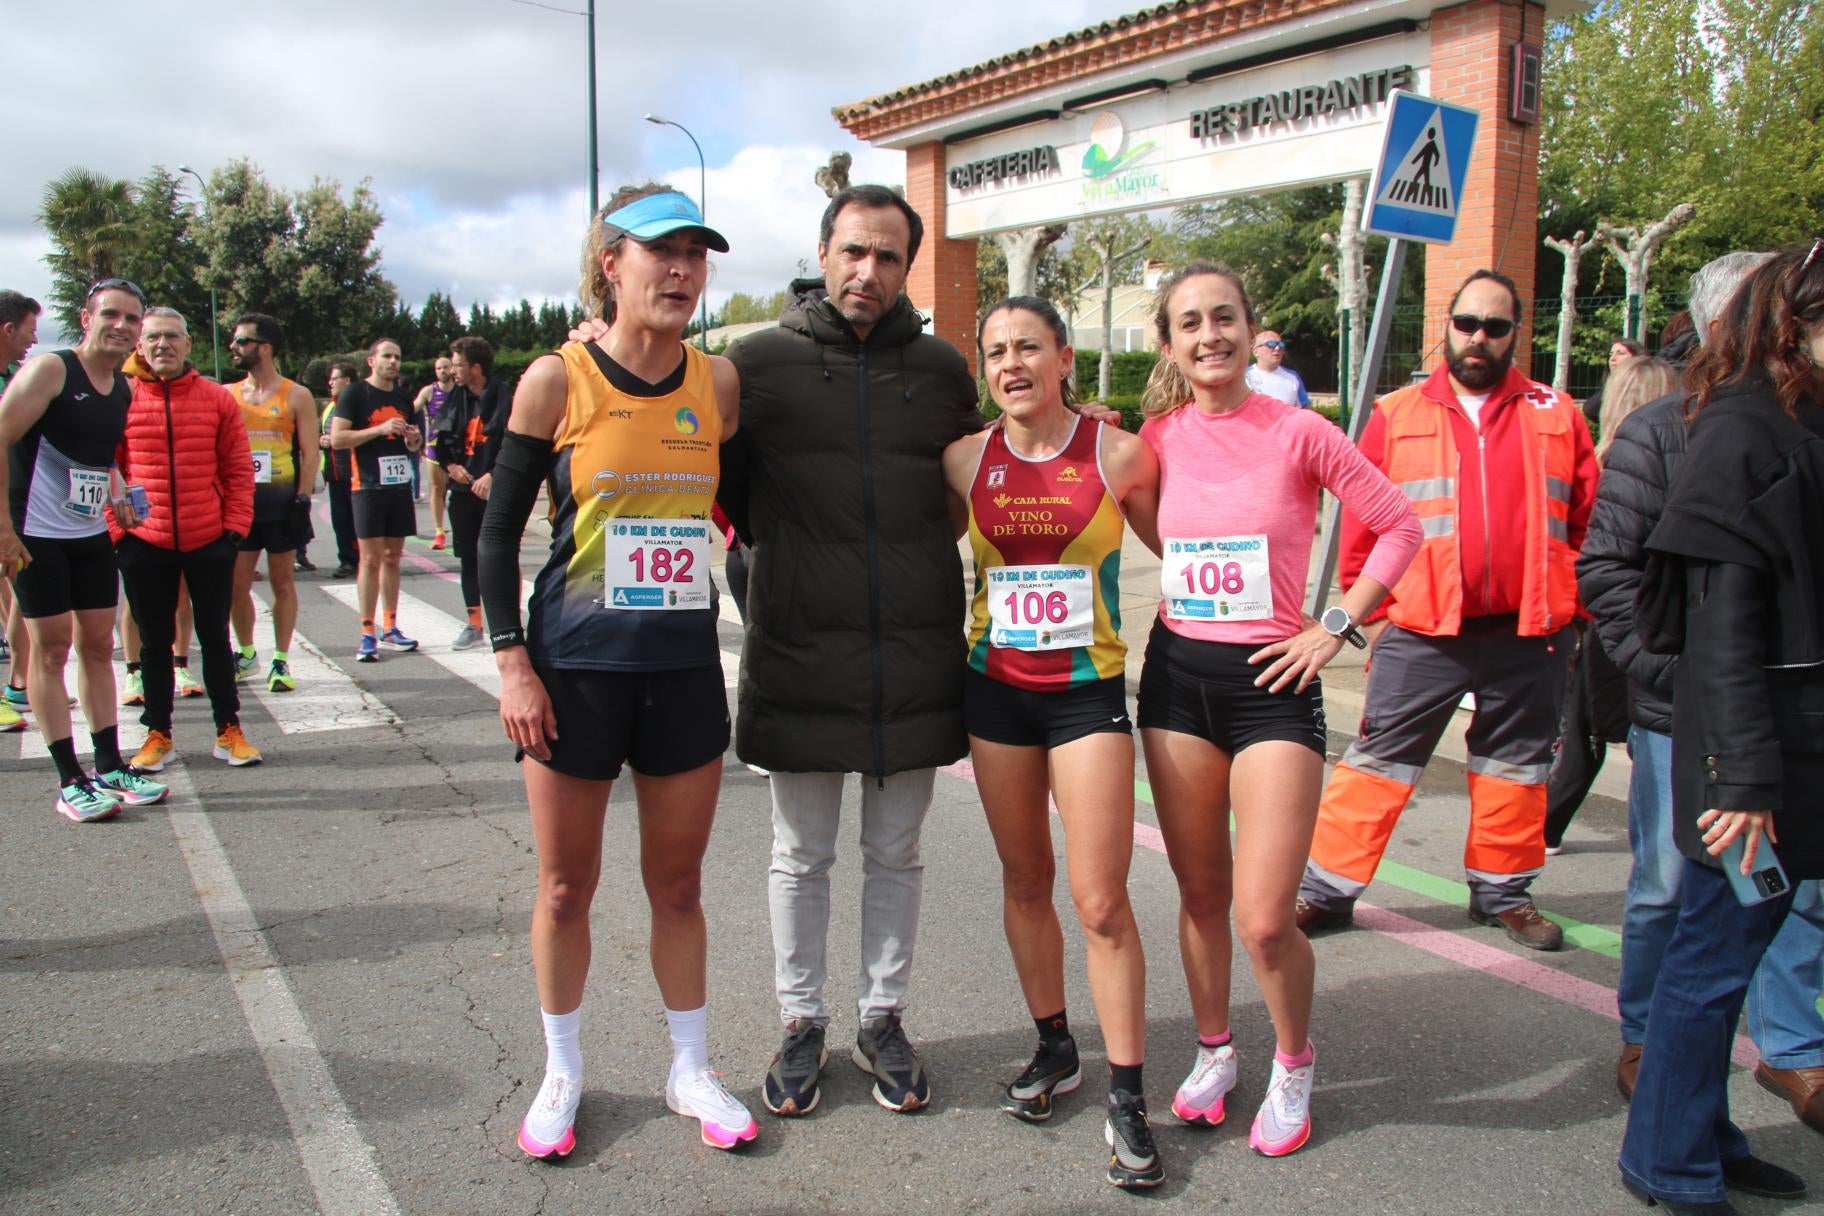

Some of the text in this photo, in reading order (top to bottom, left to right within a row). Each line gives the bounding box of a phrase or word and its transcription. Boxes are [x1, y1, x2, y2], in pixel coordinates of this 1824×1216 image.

[1189, 65, 1412, 138] RESTAURANTE
[949, 145, 1059, 189] CAFETERIA
[387, 464, 405, 476] 112
[625, 473, 660, 482] ESTER
[79, 484, 103, 504] 110
[1014, 496, 1072, 505] CAJA RURAL
[1008, 511, 1053, 522] VINO
[612, 525, 628, 536] 10
[630, 525, 648, 536] KM
[650, 526, 667, 537] DE
[993, 523, 1068, 536] DE TORO
[1170, 543, 1182, 553] 10
[628, 547, 694, 583] 182
[1023, 570, 1038, 581] DE
[1180, 561, 1245, 595] 108
[1004, 590, 1069, 625] 106
